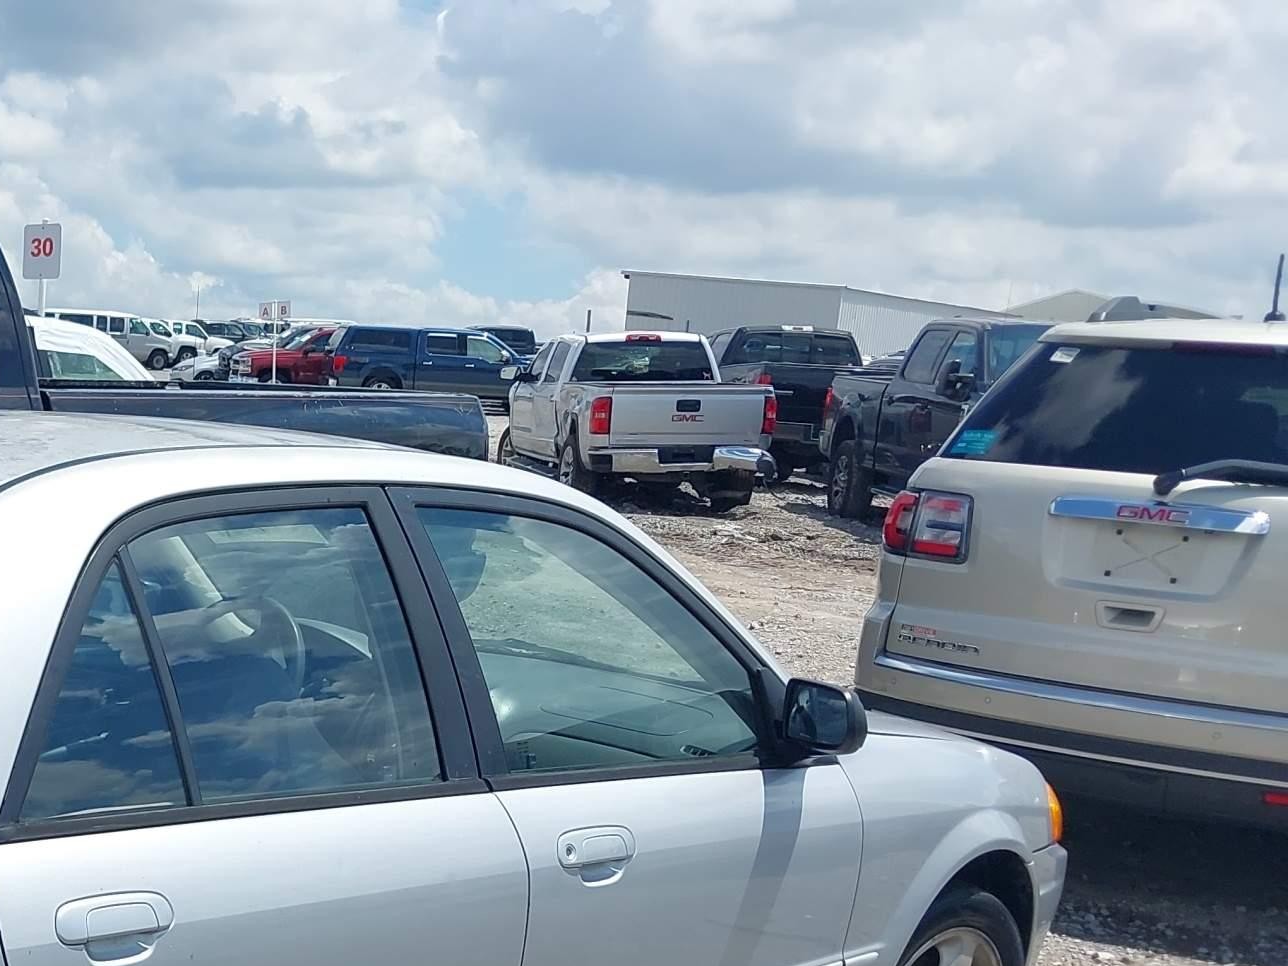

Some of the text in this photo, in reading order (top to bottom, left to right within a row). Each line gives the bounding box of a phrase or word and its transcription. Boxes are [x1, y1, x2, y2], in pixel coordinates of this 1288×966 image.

[30, 237, 54, 257] 30
[262, 306, 269, 317] A
[280, 305, 287, 315] B
[672, 414, 705, 423] GMC
[1116, 504, 1190, 524] GMC
